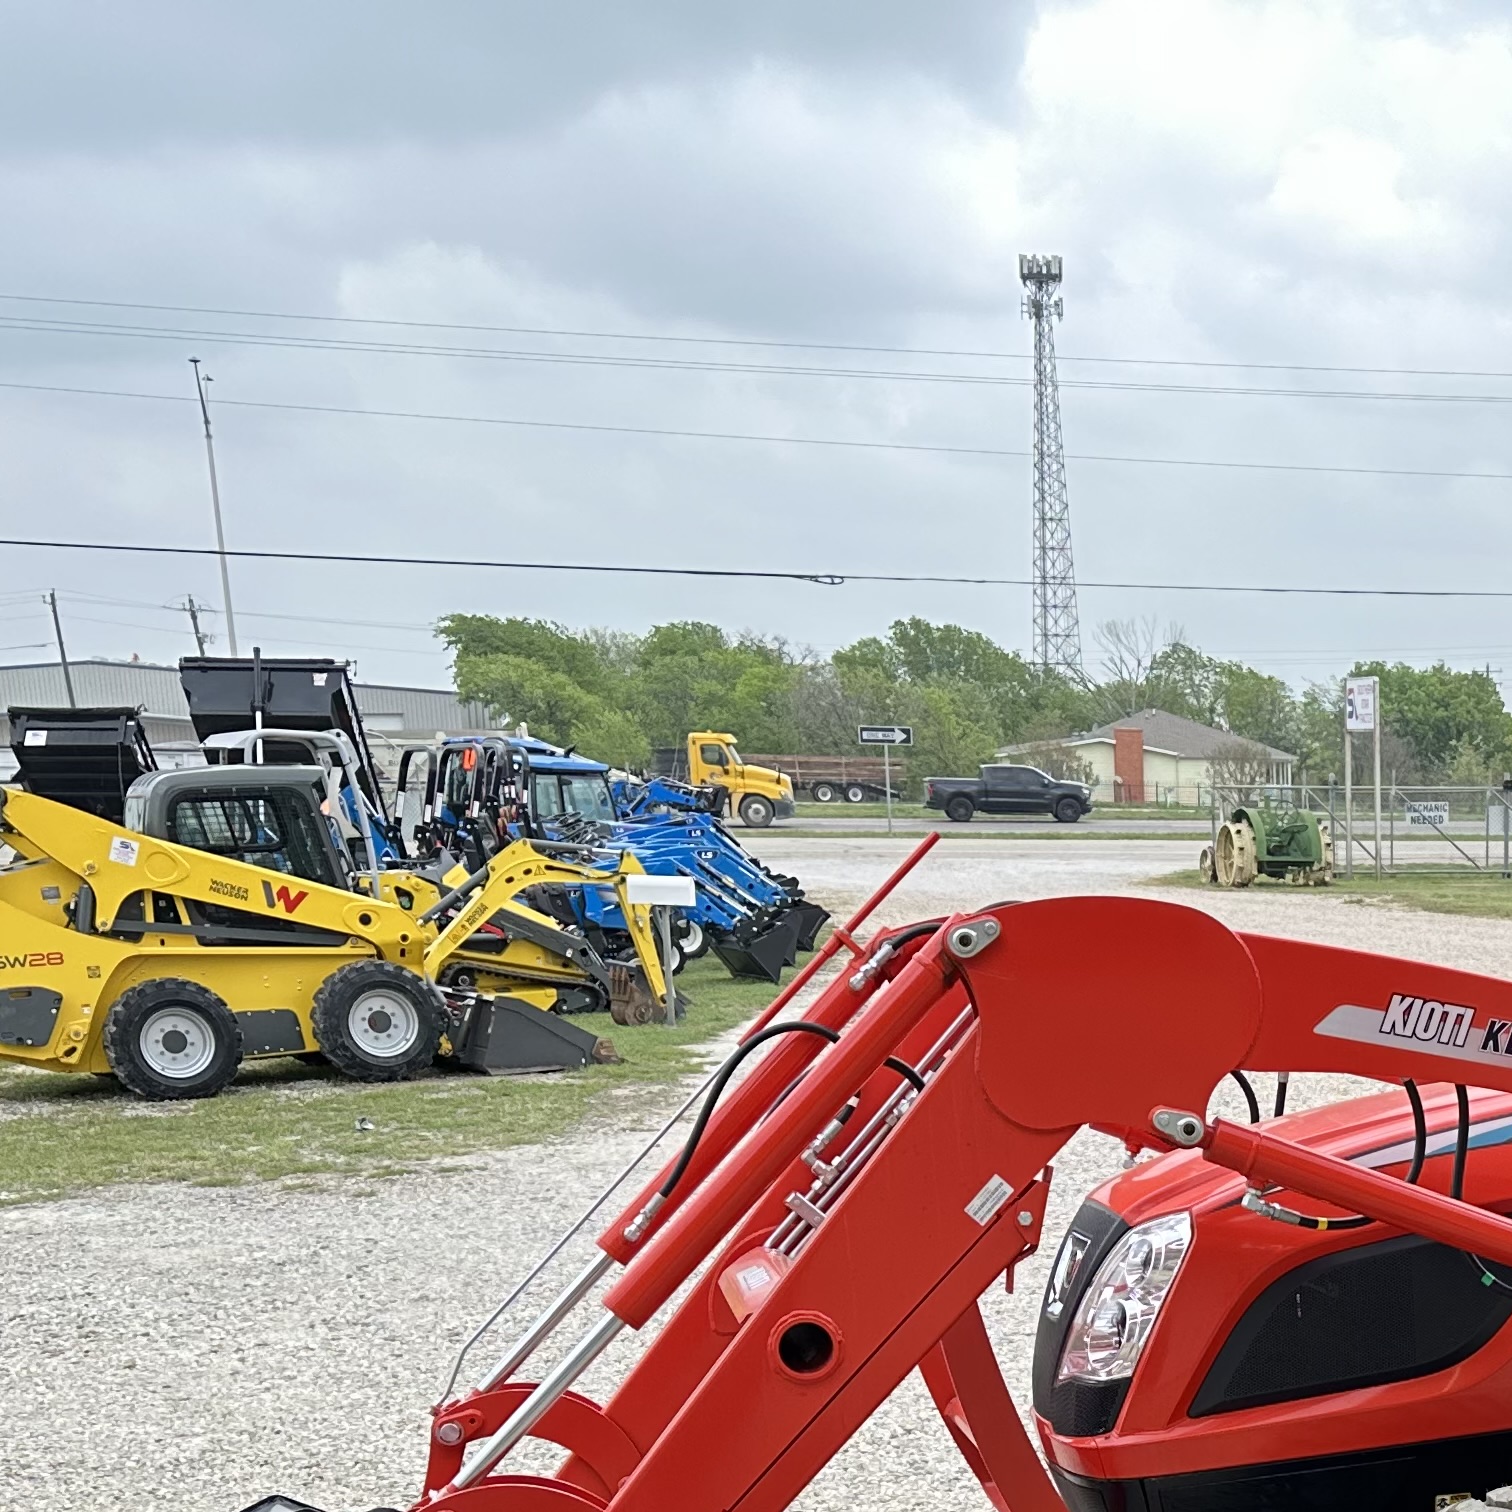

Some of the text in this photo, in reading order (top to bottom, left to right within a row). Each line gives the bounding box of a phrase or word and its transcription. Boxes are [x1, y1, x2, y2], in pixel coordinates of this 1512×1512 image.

[1406, 803, 1448, 813] MECHANIC
[1410, 815, 1444, 825] NEEDED
[691, 829, 701, 837] LS
[701, 851, 713, 859] LS
[210, 878, 249, 895] WACKER
[208, 884, 249, 902] NEUSON
[1380, 992, 1477, 1048] KIOTI
